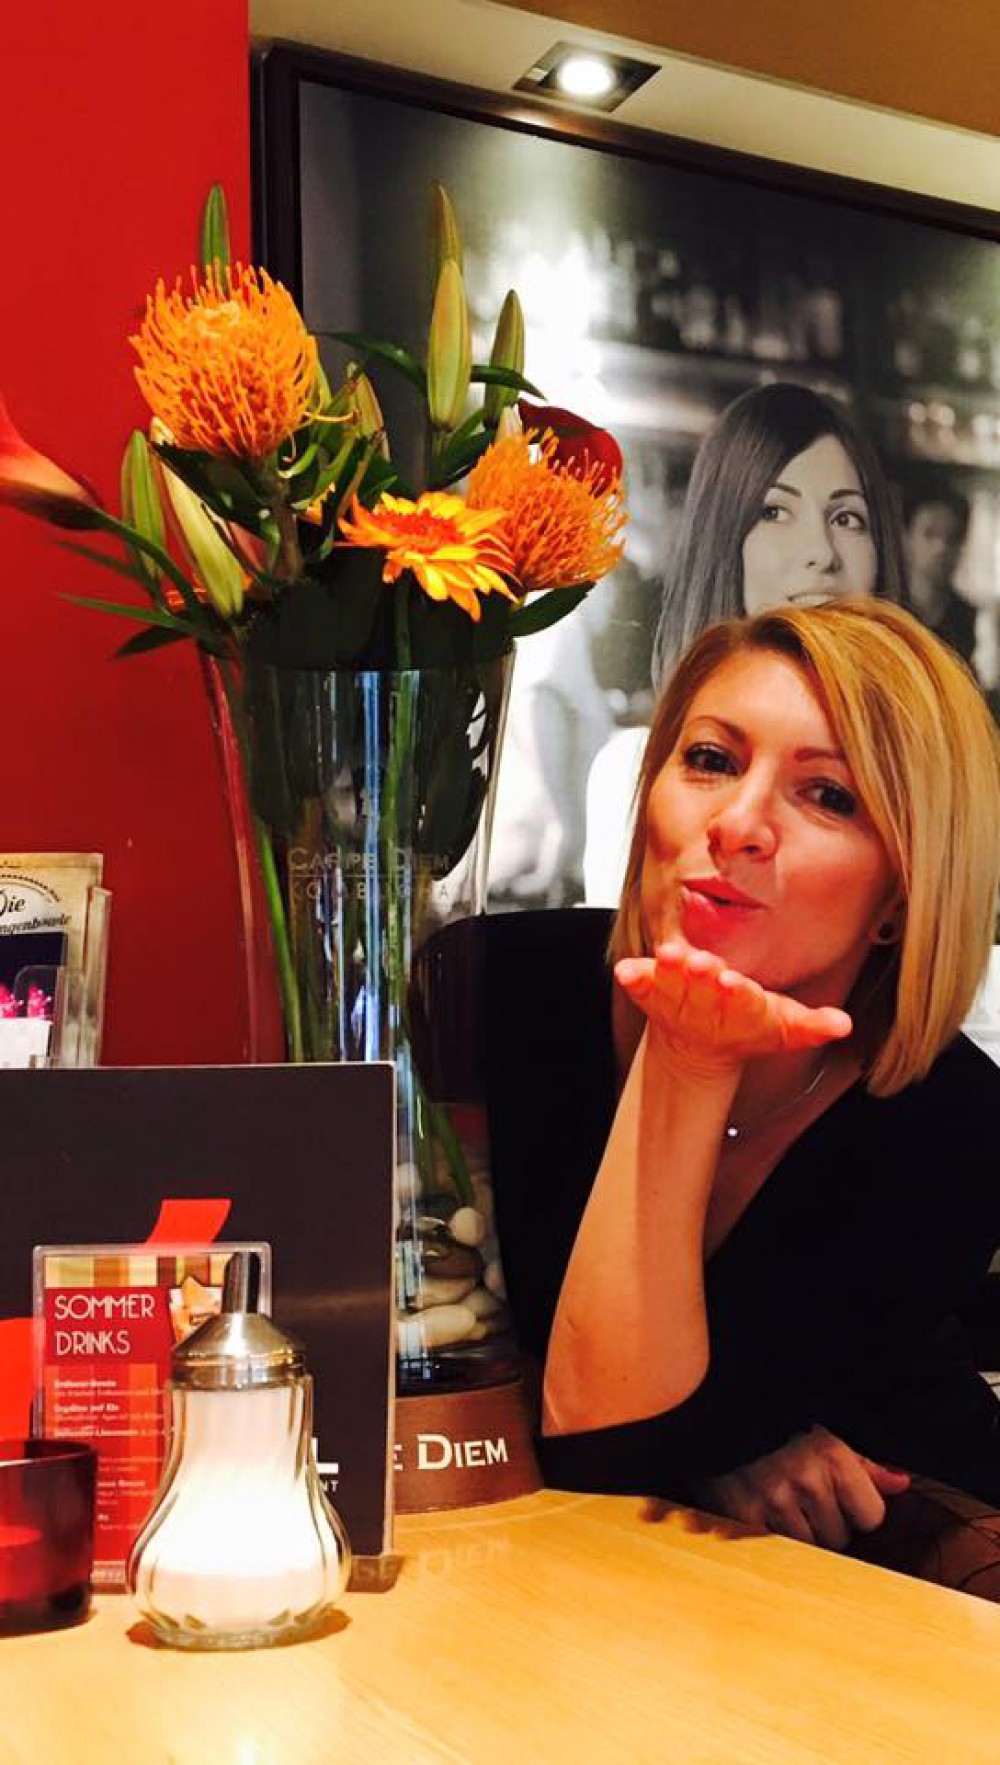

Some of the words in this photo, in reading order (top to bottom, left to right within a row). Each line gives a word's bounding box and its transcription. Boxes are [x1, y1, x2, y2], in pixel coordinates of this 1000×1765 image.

[54, 1294, 155, 1319] SOMMER
[56, 1331, 130, 1355] DRINKS
[417, 1434, 508, 1470] DIEM
